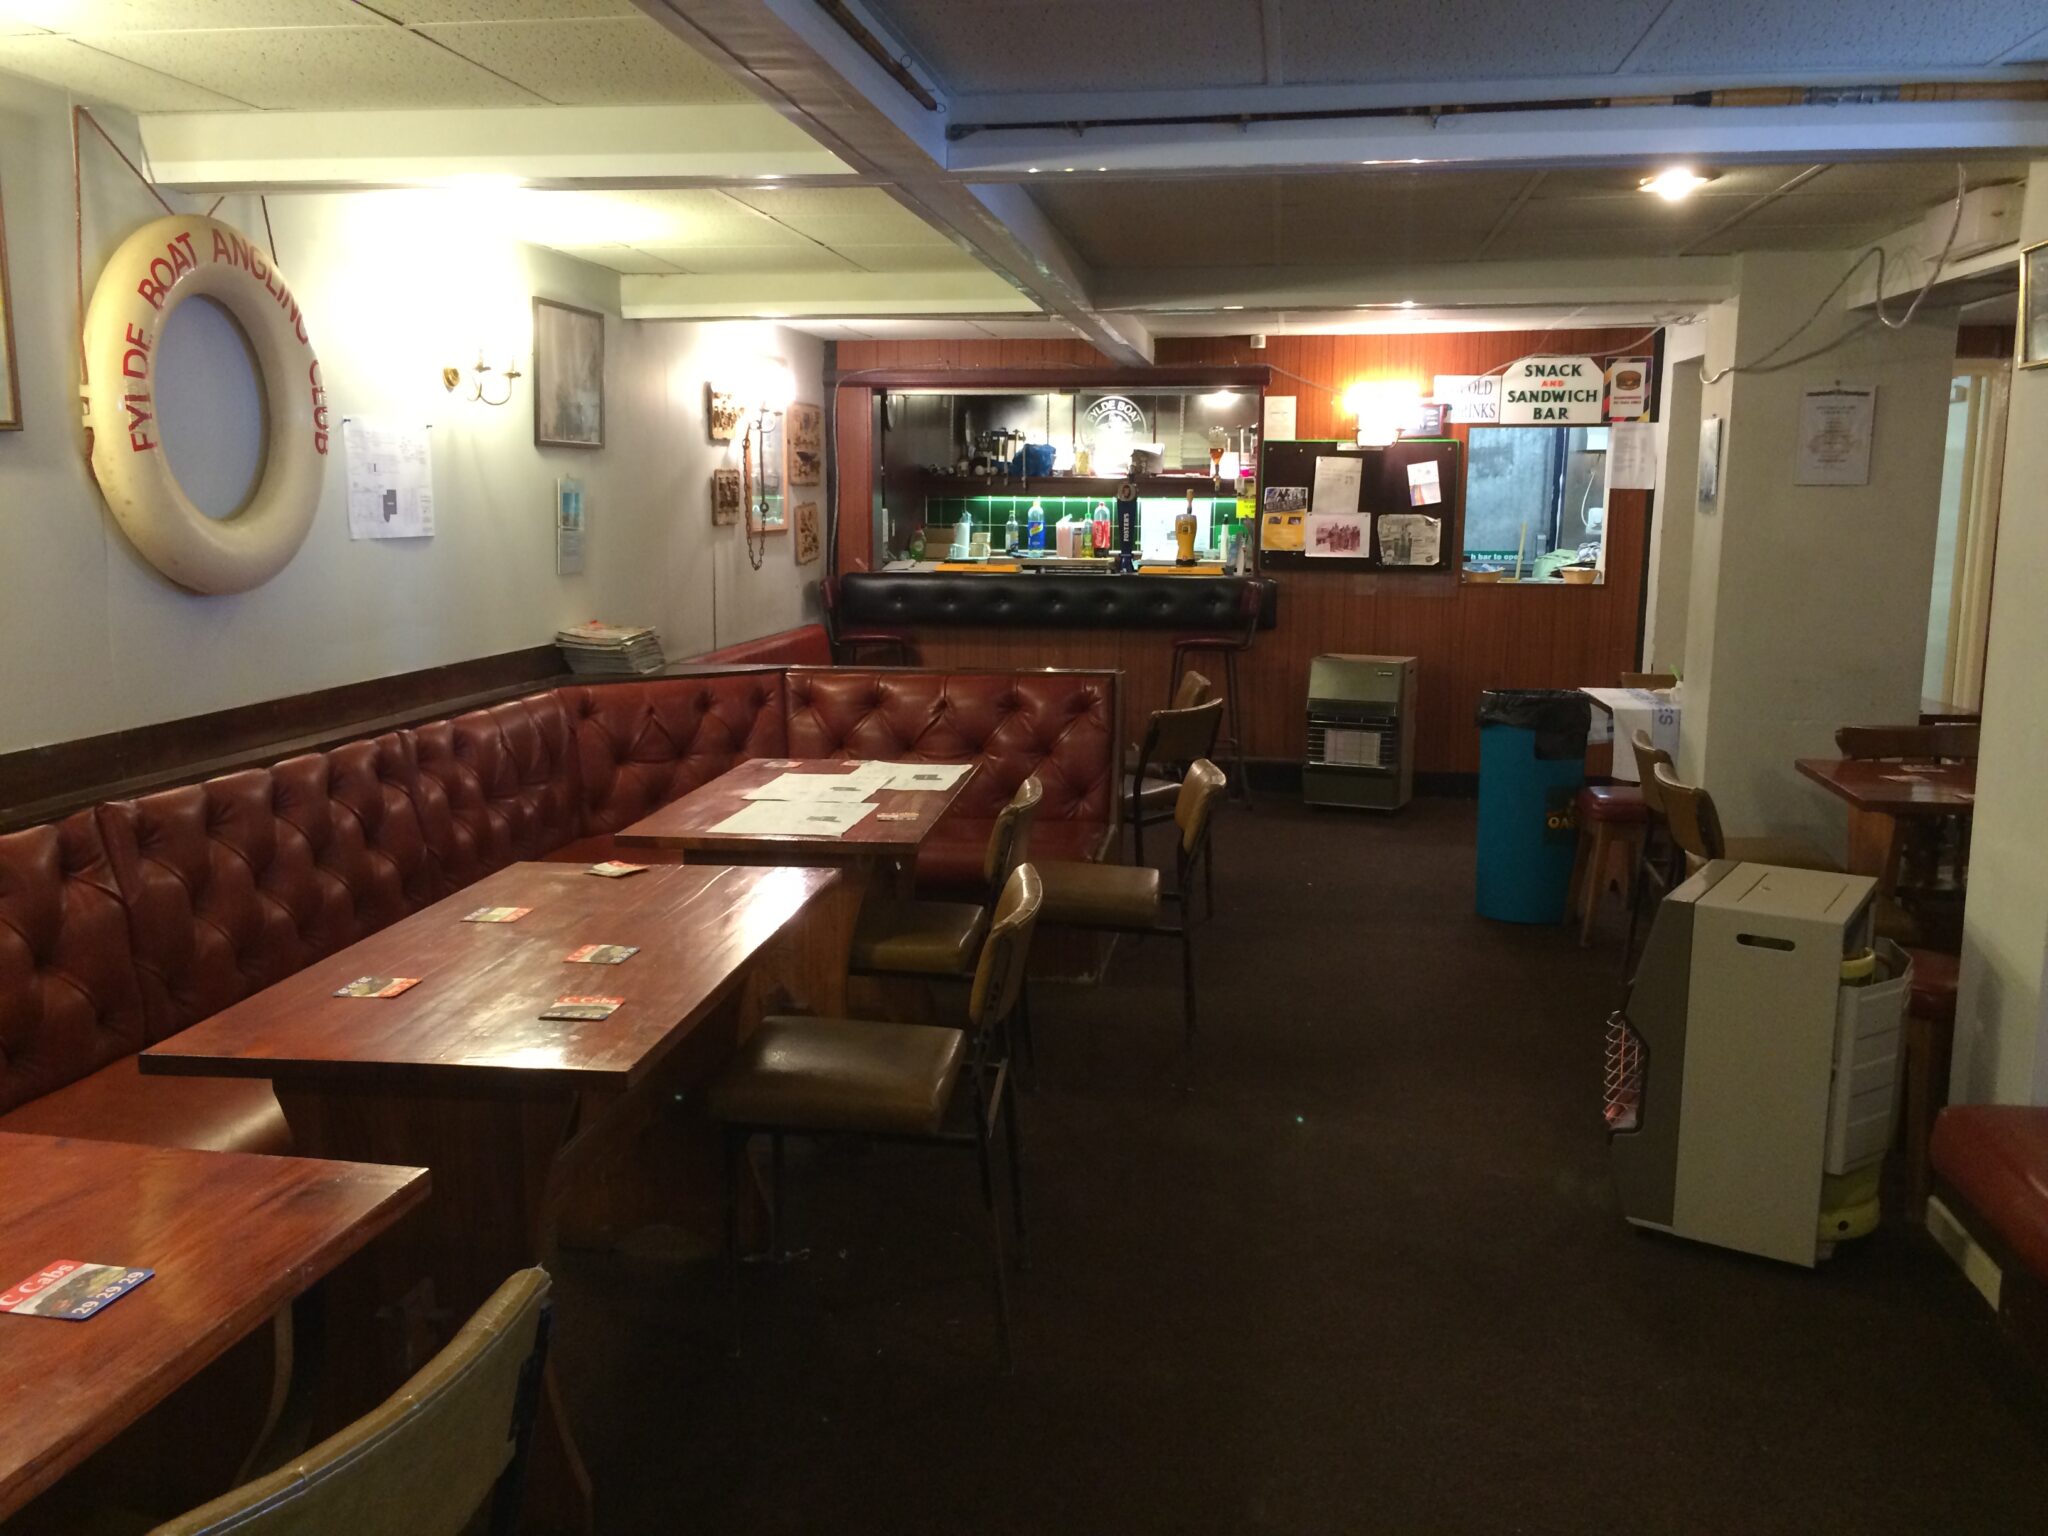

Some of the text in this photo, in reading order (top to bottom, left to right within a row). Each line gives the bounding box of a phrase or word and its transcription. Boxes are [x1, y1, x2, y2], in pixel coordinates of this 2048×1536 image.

[137, 231, 197, 311] BOAT
[1524, 363, 1582, 377] SNACK
[1541, 379, 1565, 388] AND
[1507, 389, 1598, 403] SANDWICH
[1087, 400, 1141, 422] FYLDE BOAT
[1533, 407, 1569, 420] BAR
[18, 1264, 75, 1294] Cabs
[71, 1271, 145, 1315] 29 29 29
